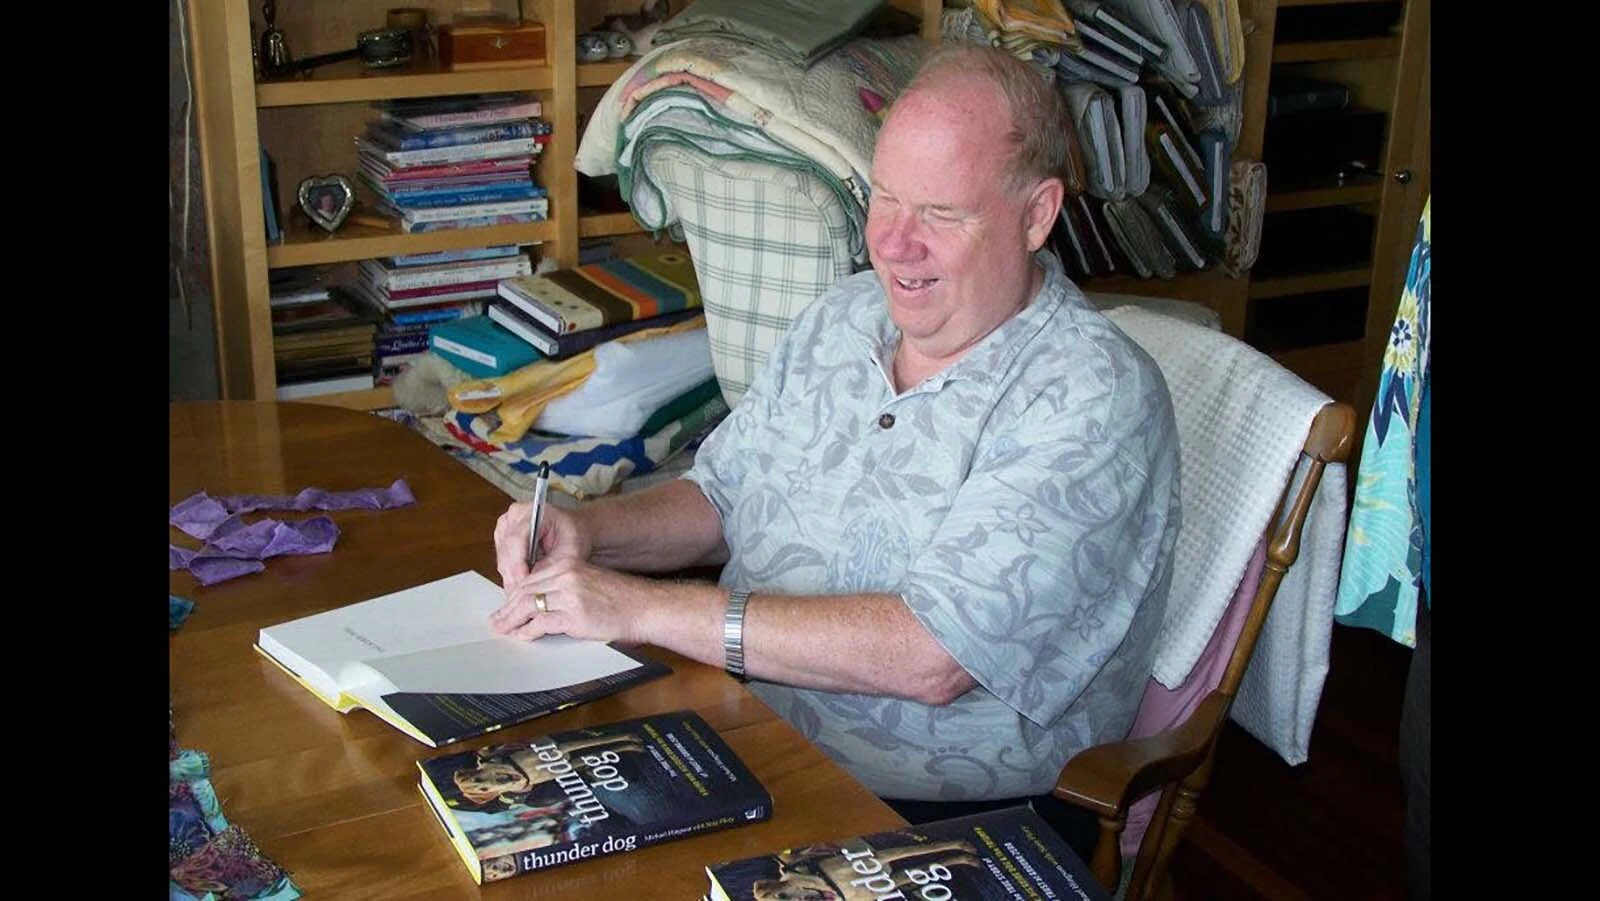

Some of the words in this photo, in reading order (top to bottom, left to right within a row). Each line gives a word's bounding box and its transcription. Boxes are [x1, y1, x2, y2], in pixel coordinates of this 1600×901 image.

[530, 742, 609, 825] thunder
[581, 751, 629, 791] dog
[523, 842, 599, 871] thunder
[602, 834, 637, 852] dog
[904, 863, 953, 901] og
